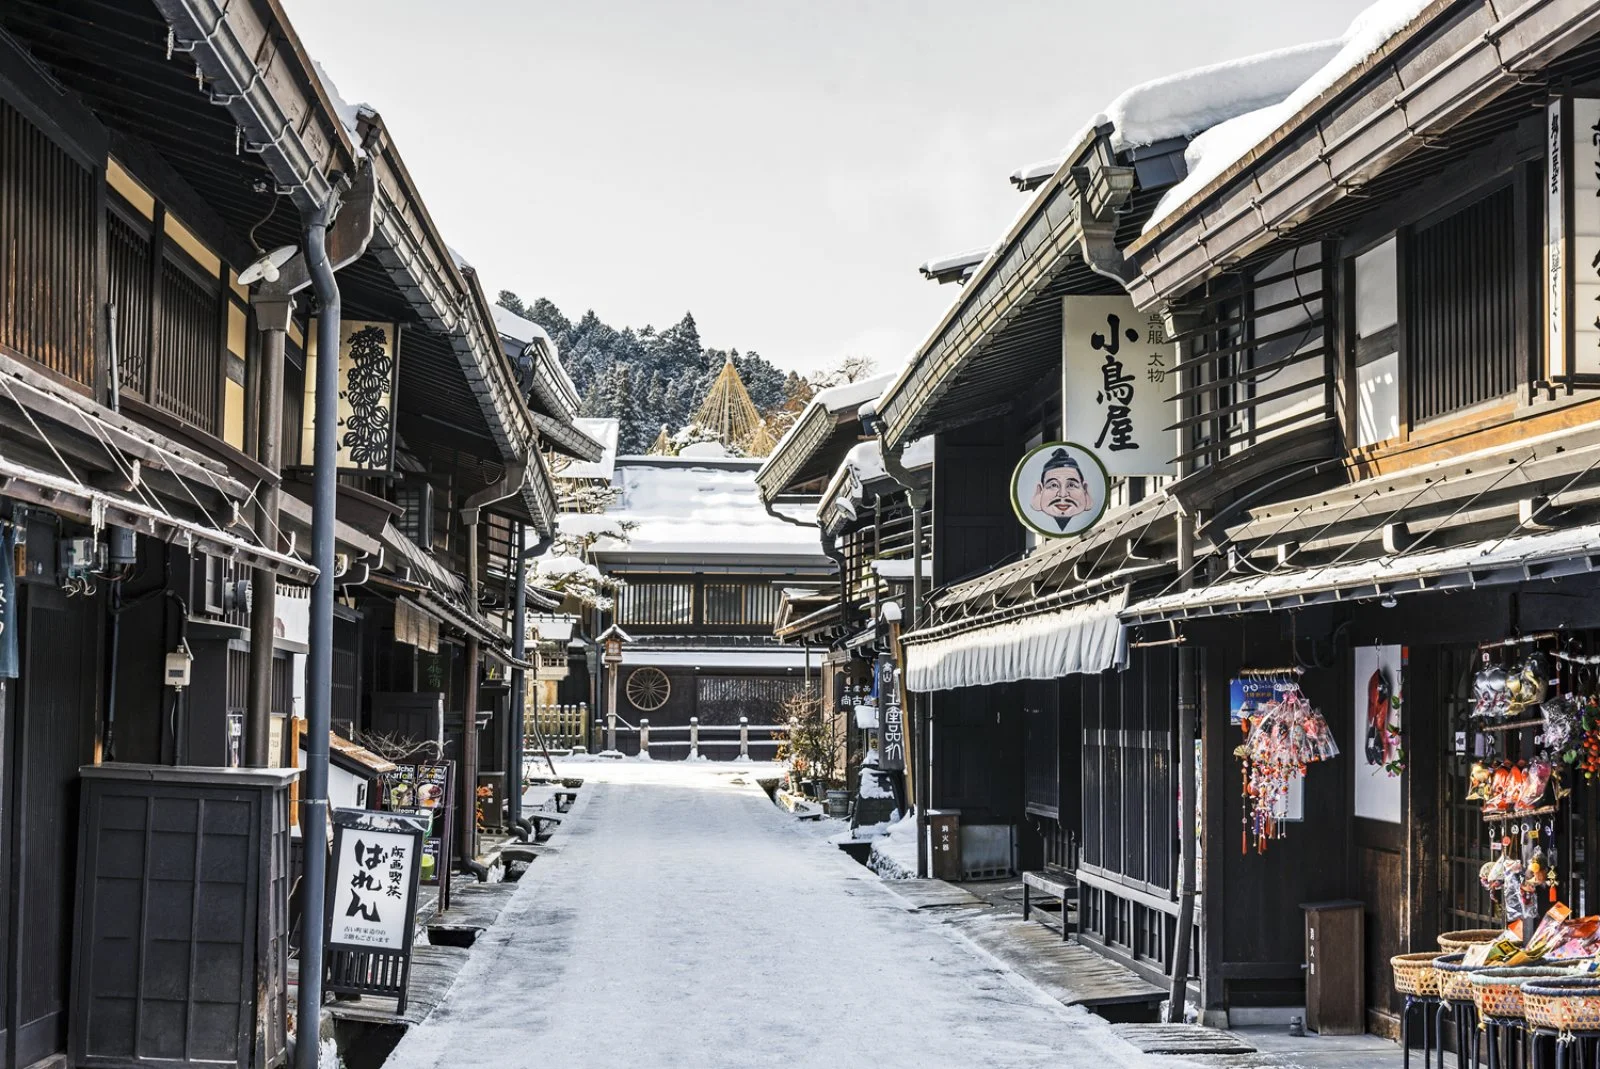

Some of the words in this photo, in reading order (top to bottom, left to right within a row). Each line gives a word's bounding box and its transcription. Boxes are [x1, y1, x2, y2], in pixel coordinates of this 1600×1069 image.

[1147, 314, 1165, 345] 呉服
[1091, 313, 1140, 451] 小鳥屋
[1147, 352, 1166, 383] 太物
[345, 838, 389, 922] ばれん
[386, 845, 406, 899] 版画喫茶
